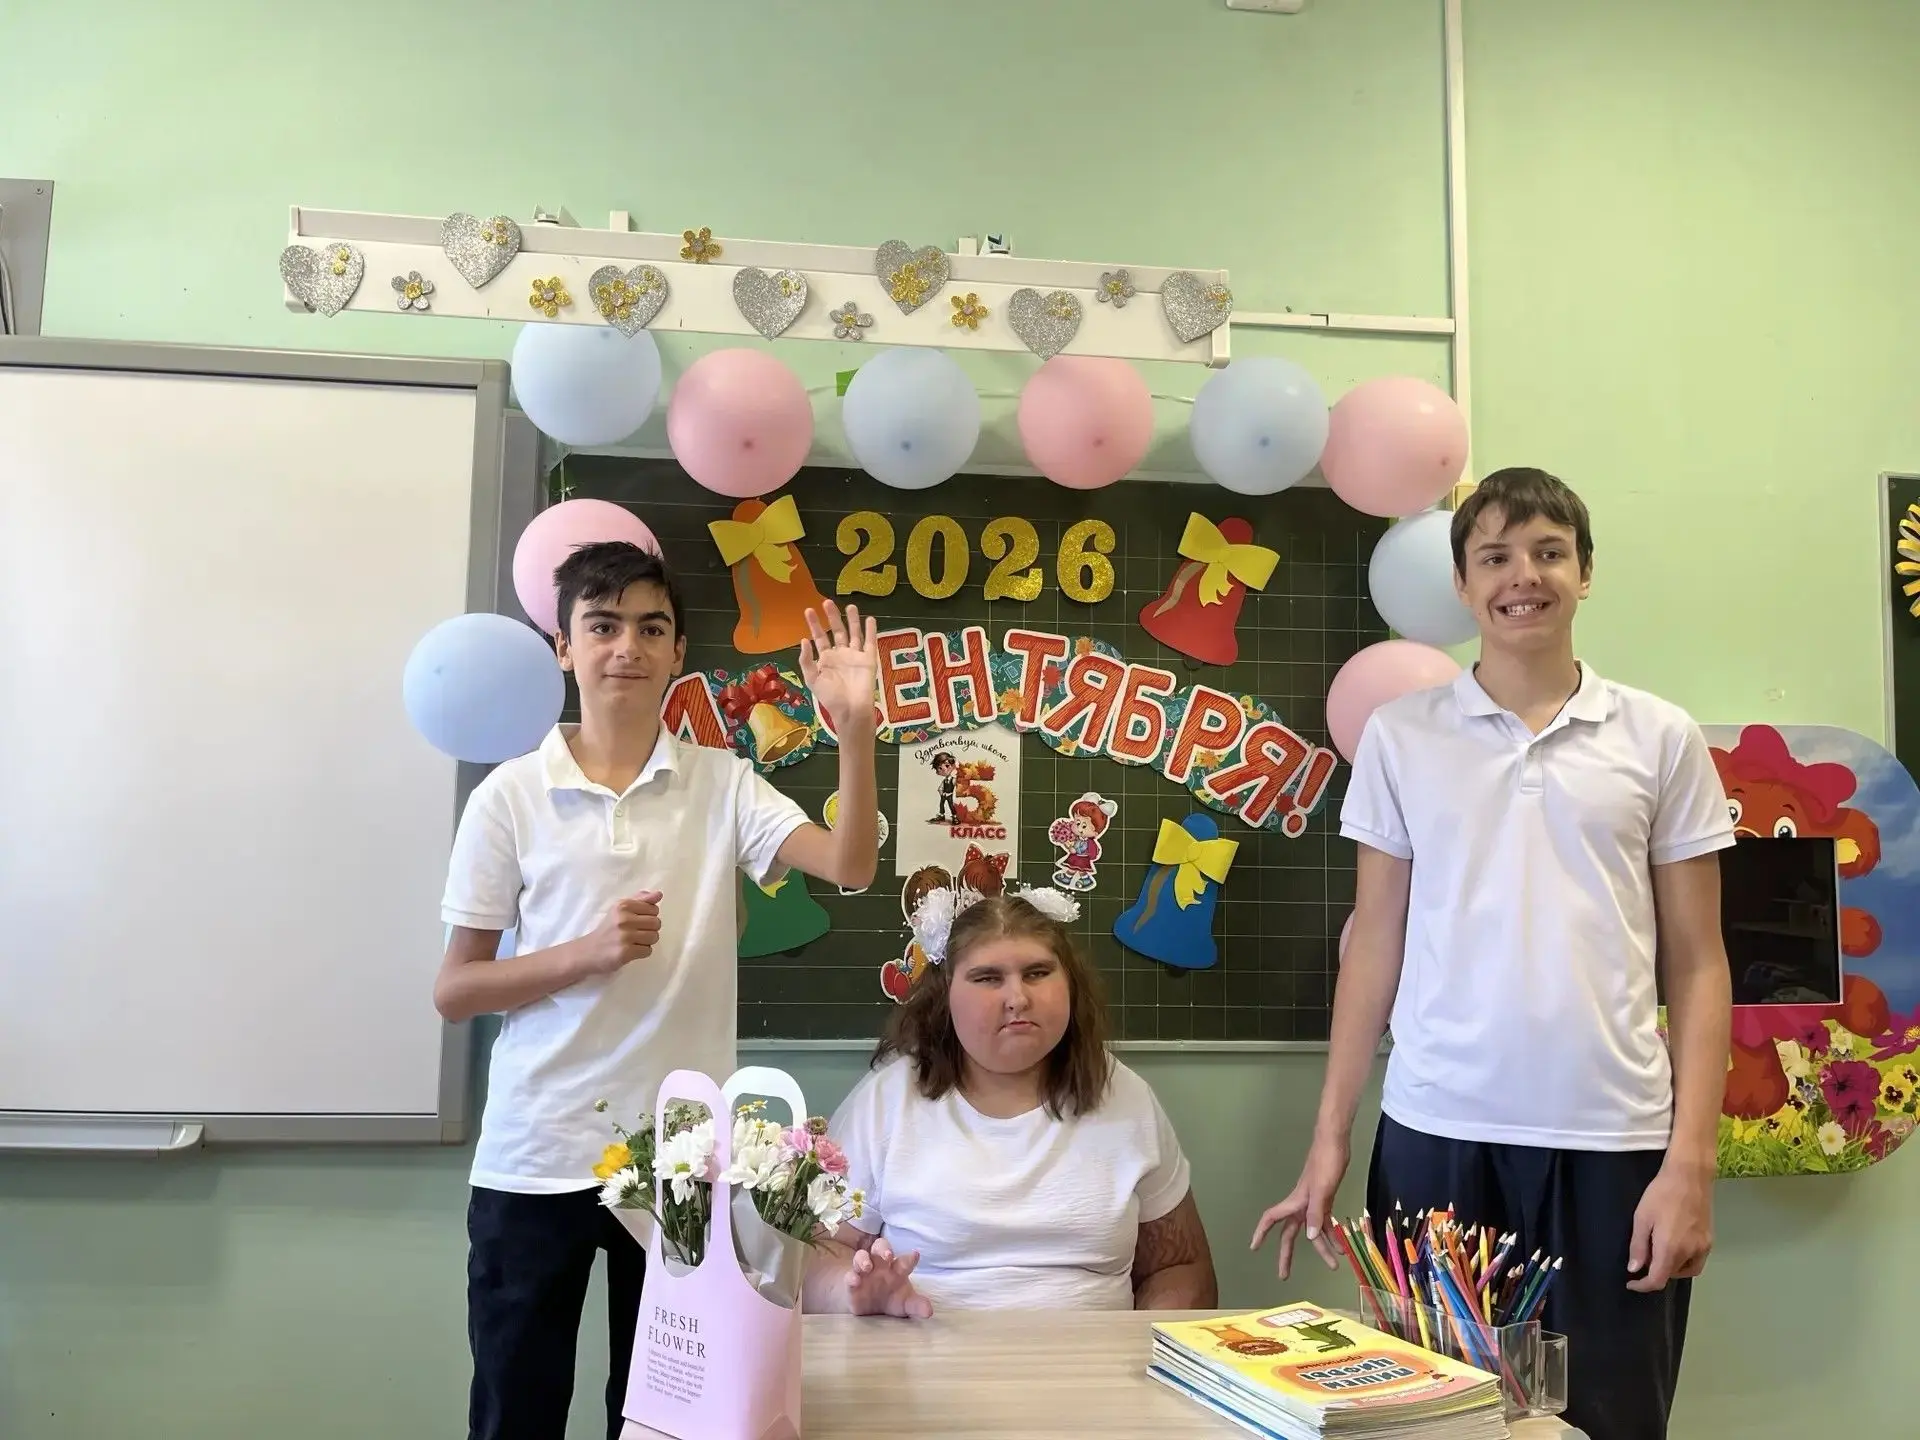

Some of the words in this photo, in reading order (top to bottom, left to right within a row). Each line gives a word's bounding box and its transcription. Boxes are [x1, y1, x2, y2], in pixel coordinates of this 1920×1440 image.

[836, 511, 1116, 603] 2026
[813, 626, 1338, 838] ЕНТЯБРЯ!
[981, 744, 1009, 763] школа
[954, 760, 998, 824] 5
[950, 827, 1007, 840] КЛАСС
[654, 1306, 700, 1334] FRESH
[648, 1325, 706, 1359] FLOWER
[1299, 1358, 1396, 1381] ЦИФРЫ
[1321, 1367, 1415, 1391] ПИШЕМ
